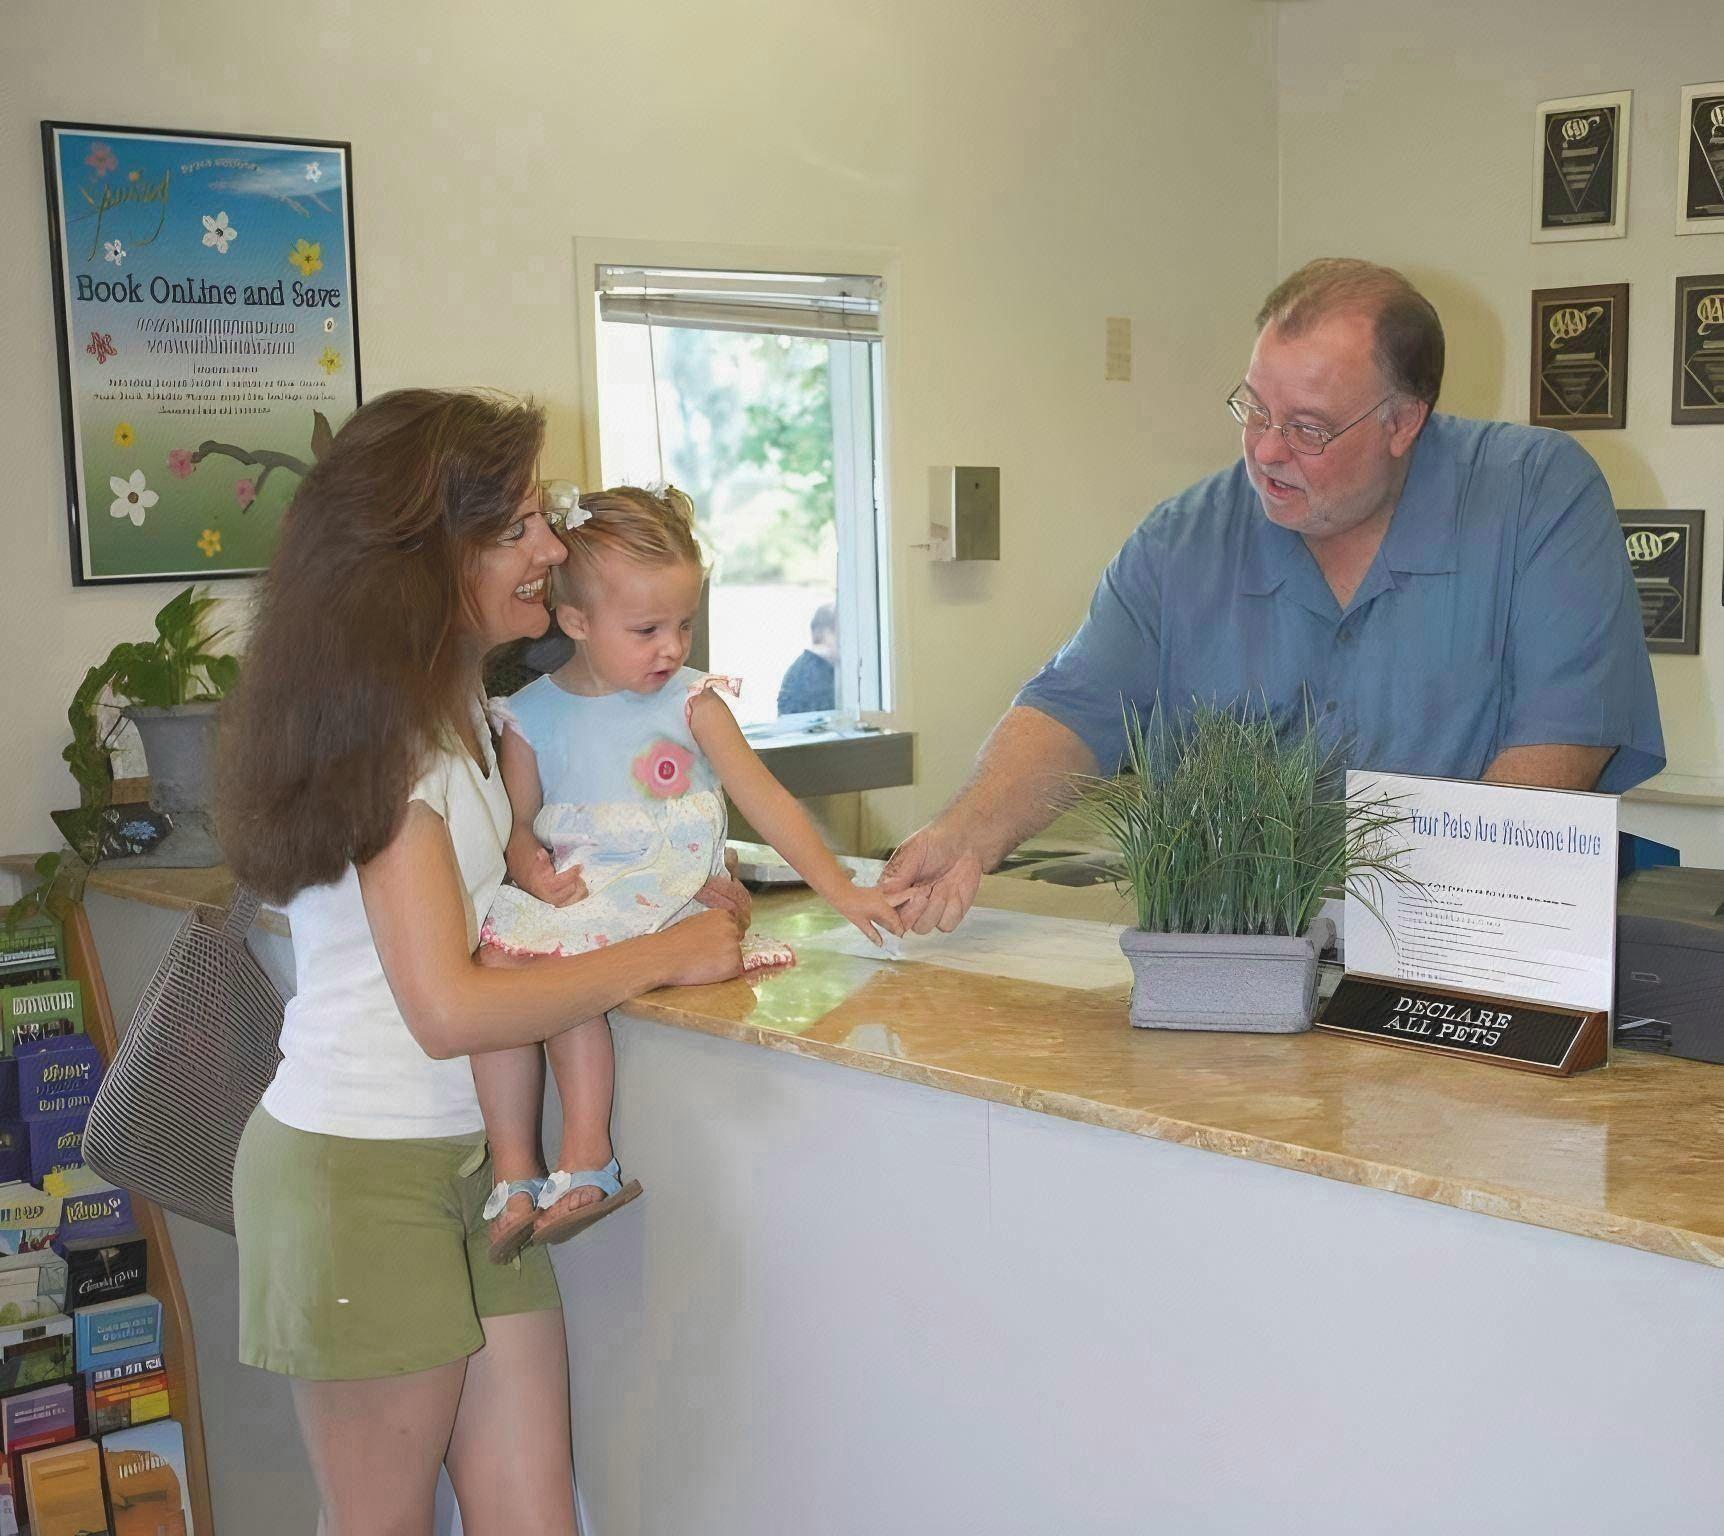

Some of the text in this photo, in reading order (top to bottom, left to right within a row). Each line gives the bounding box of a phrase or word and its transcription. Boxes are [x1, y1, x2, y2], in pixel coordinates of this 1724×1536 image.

[76, 273, 144, 303] Book
[243, 279, 286, 306] and
[291, 280, 341, 308] Save
[1443, 811, 1472, 841] Pets
[1568, 824, 1601, 856] Here
[1393, 996, 1513, 1029] DECLARE
[1382, 1015, 1501, 1047] ALL PETS
